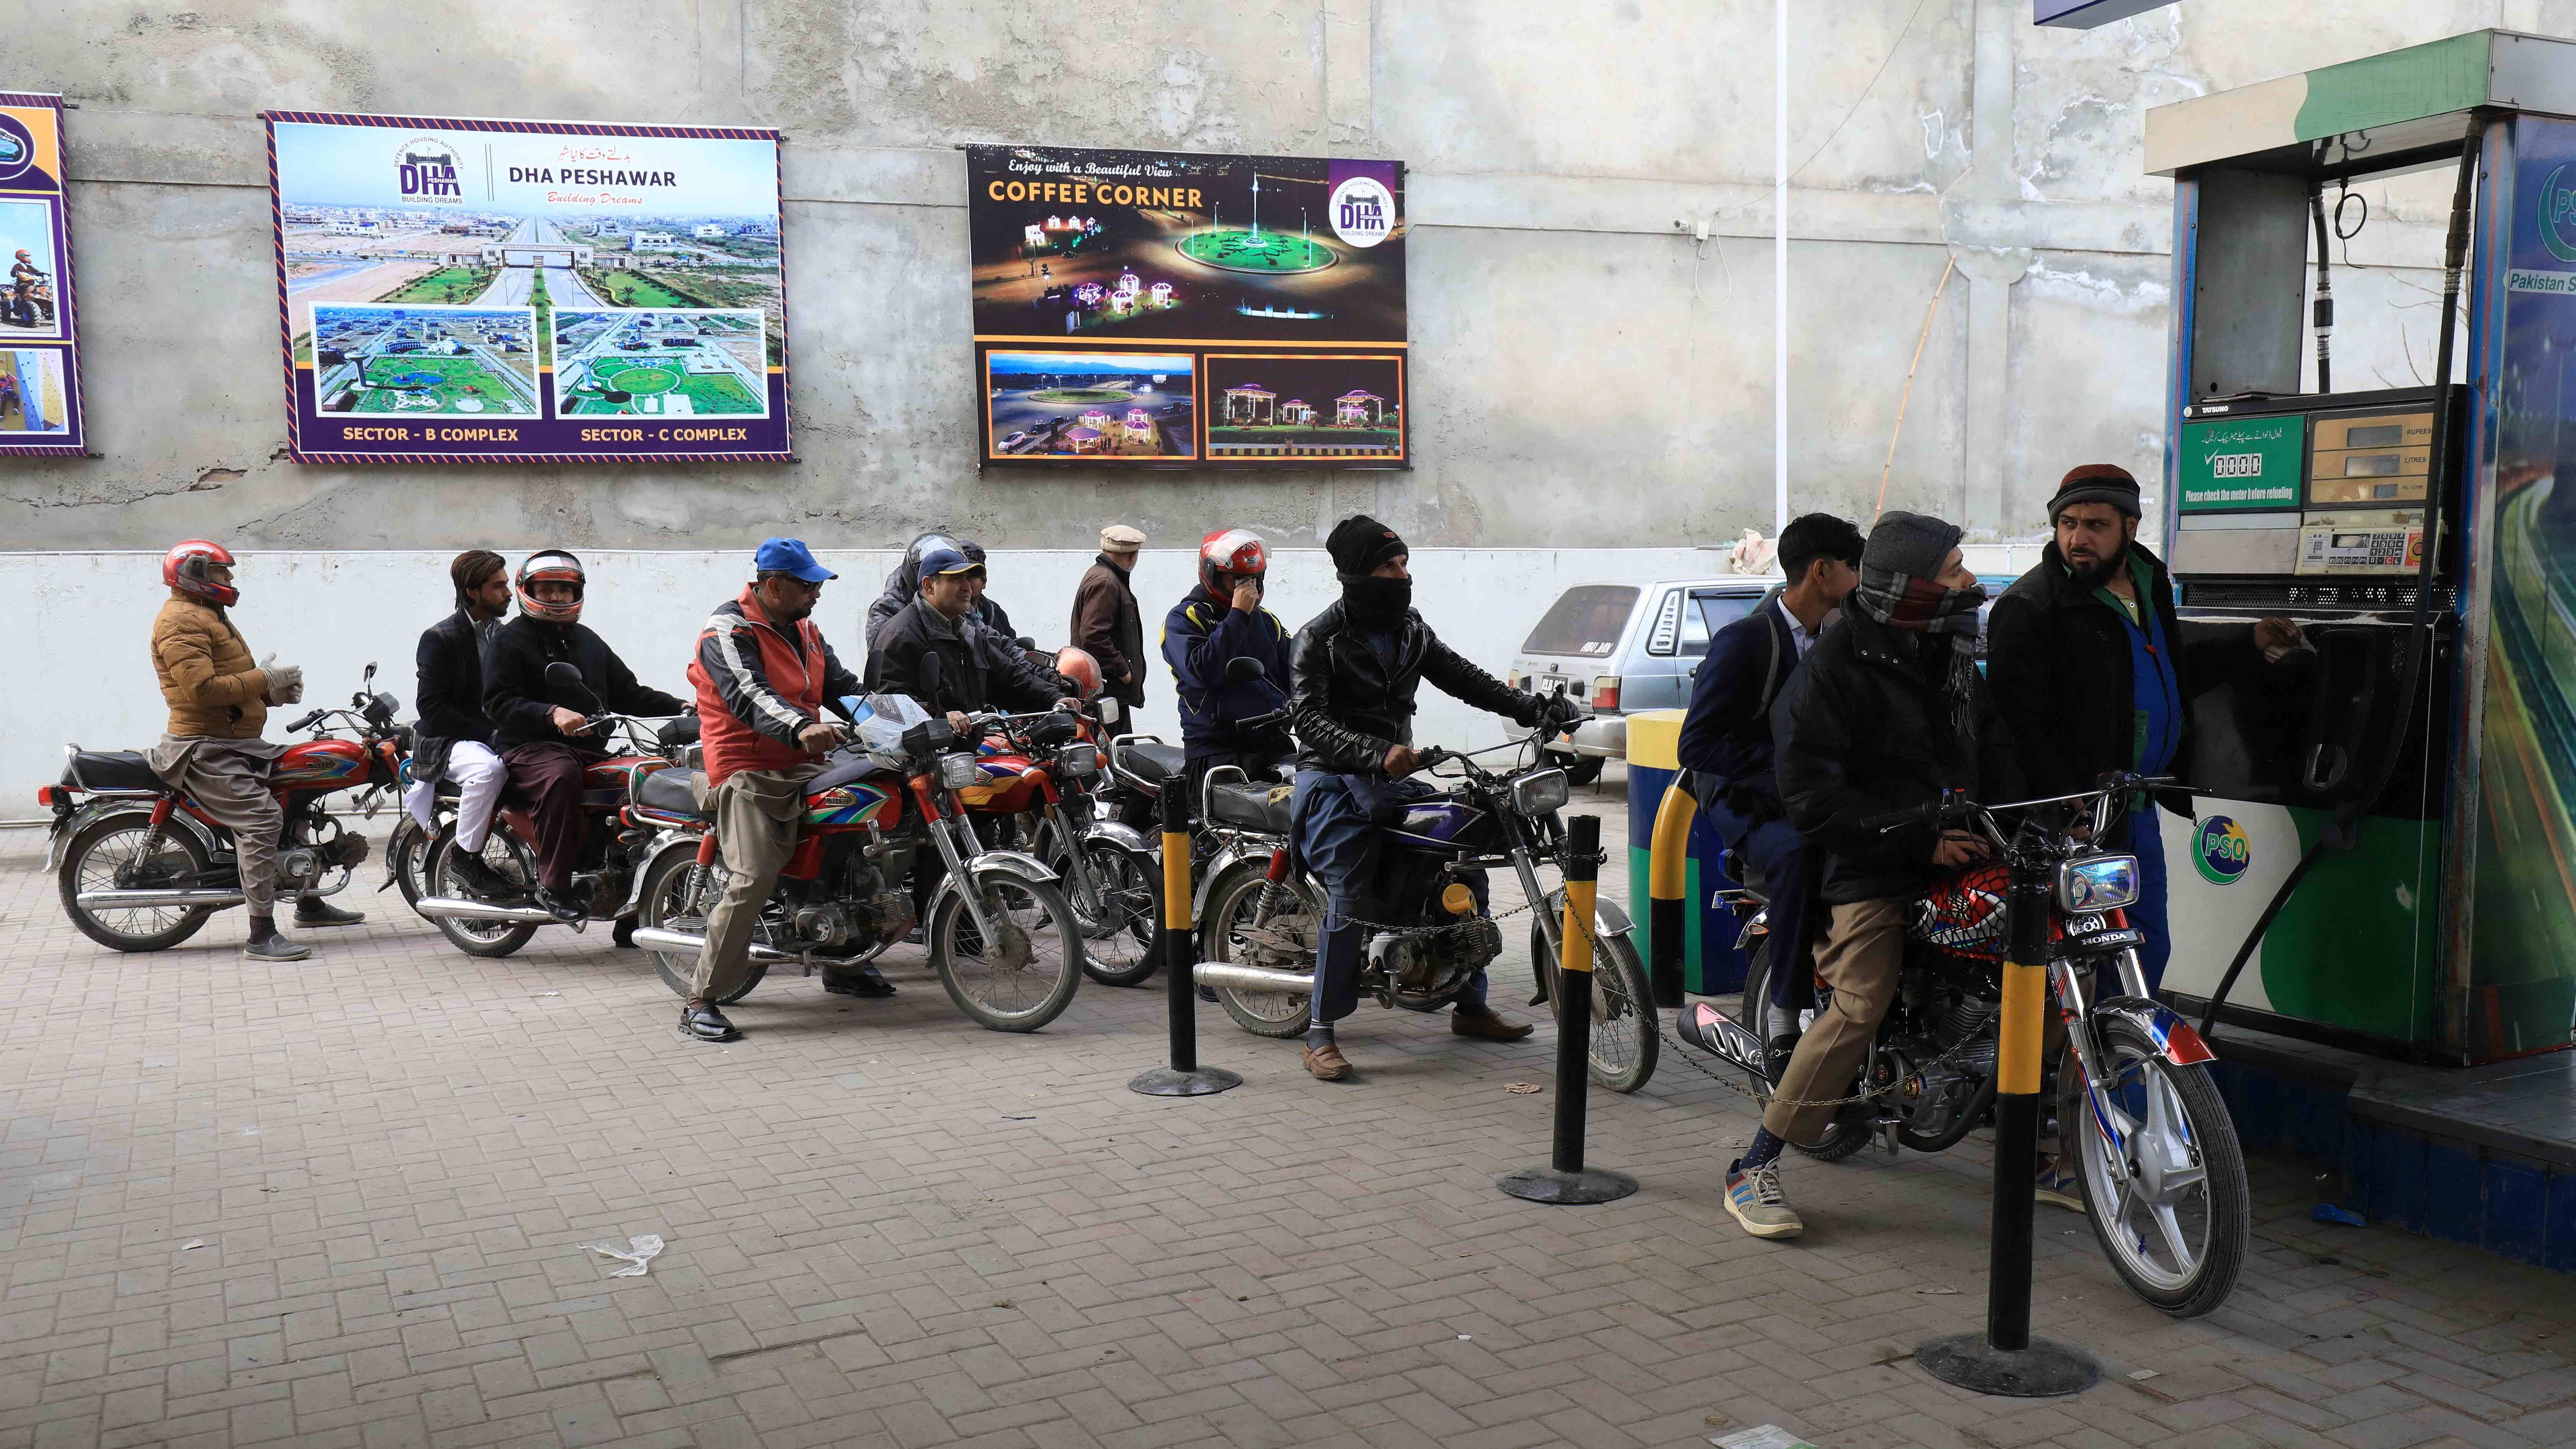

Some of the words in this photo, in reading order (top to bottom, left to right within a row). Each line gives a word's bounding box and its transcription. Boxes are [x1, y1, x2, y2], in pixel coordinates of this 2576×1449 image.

[394, 142, 410, 168] DEFENCE
[440, 141, 464, 170] AUTHORITY
[509, 167, 554, 184] DHA
[561, 169, 677, 187] PESHAWAR
[1009, 159, 1043, 175] Enjoy
[1046, 161, 1071, 173] with
[1085, 162, 1141, 178] Beautiful
[1144, 167, 1173, 177] View
[400, 164, 461, 196] DHA
[547, 191, 596, 206] Building
[600, 193, 644, 204] Dreams
[989, 181, 1088, 204] COFFEE
[1097, 185, 1203, 208] CORNER
[1336, 186, 1349, 207] DEFENCE
[1371, 184, 1388, 208] AUTHORITY
[1341, 204, 1385, 230] DHA
[2510, 273, 2564, 291] Pakistan
[343, 427, 409, 441] SECTOR
[426, 428, 436, 440] B
[441, 428, 519, 441] COMPLEX
[581, 429, 644, 441] SECTOR
[659, 429, 669, 441] C
[674, 428, 747, 441] COMPLEX
[2185, 490, 2203, 502] Please
[2204, 489, 2220, 501] check
[2221, 488, 2230, 500] the
[2230, 489, 2247, 500] meter
[2248, 487, 2266, 500] before
[2267, 486, 2293, 499] refueling
[1341, 731, 1372, 748] ARMANI
[2205, 833, 2246, 860] PSO
[2081, 933, 2127, 945] HONDA
